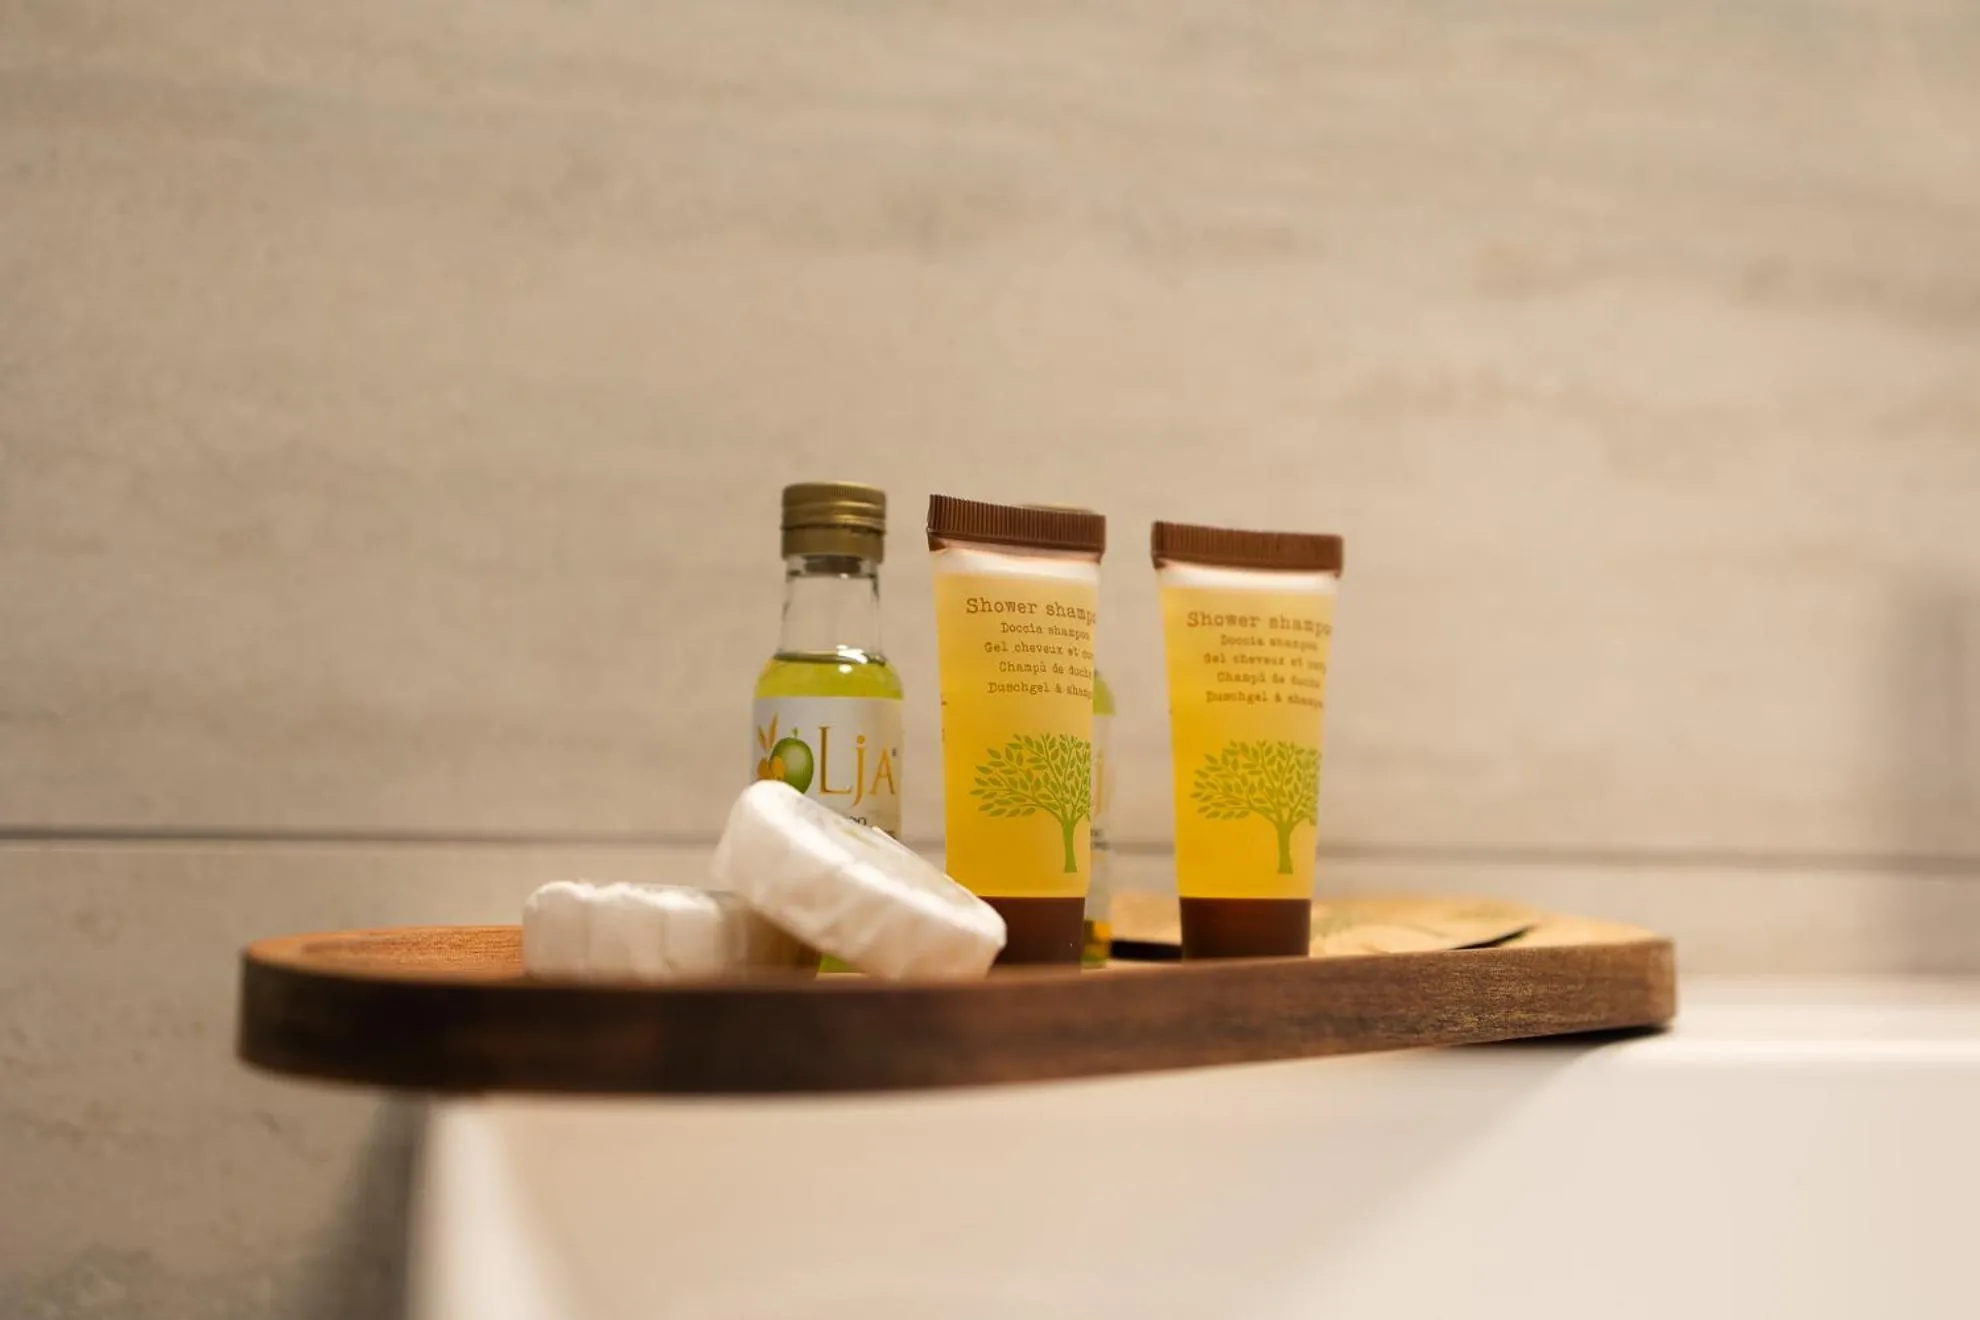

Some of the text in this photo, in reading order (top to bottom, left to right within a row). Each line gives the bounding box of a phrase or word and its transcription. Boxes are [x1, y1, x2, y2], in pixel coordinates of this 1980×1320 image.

[966, 597, 1037, 614] Shower
[1187, 611, 1261, 628] Shower
[1000, 621, 1043, 634] Doccia
[984, 641, 1008, 653] Gel
[1014, 641, 1063, 656] cheveux
[1068, 646, 1079, 657] et
[1203, 652, 1226, 665] Gel
[1052, 663, 1064, 674] de
[987, 682, 1050, 696] Duschgel
